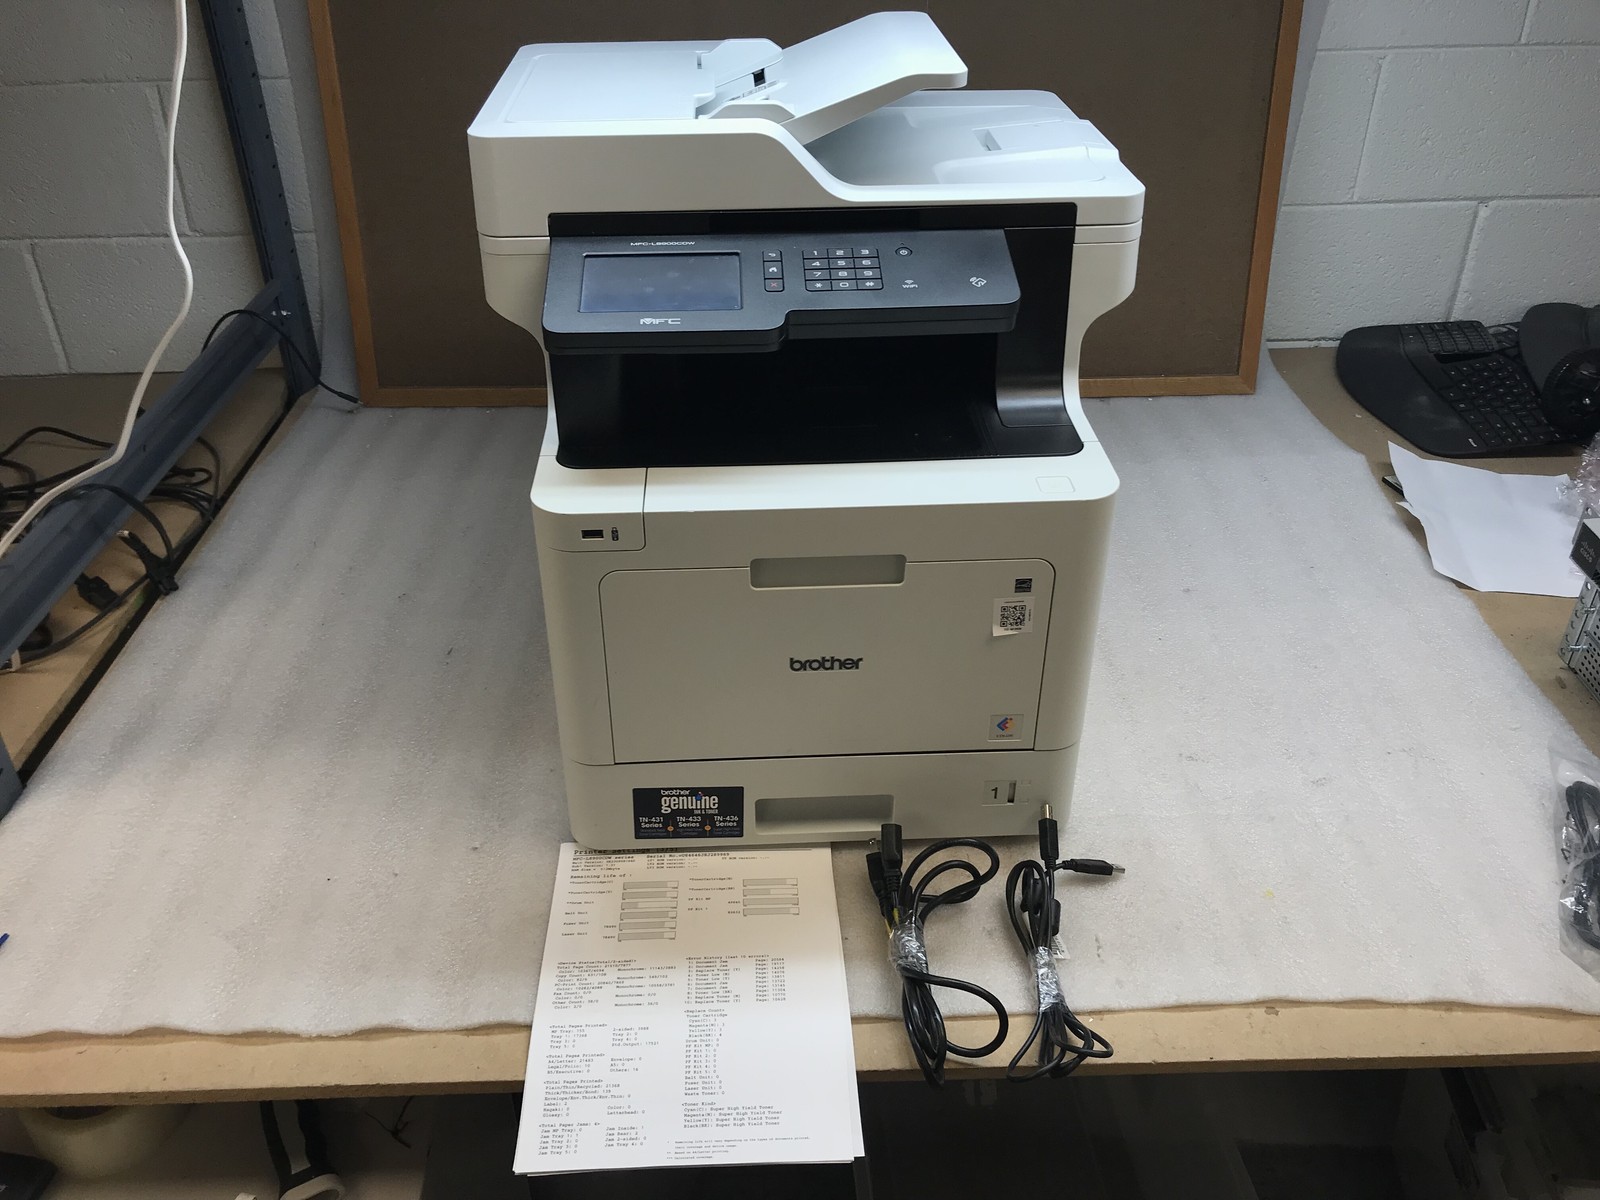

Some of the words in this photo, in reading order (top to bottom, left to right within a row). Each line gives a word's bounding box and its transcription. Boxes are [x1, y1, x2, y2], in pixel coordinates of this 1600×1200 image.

[790, 656, 863, 672] brother
[992, 787, 998, 799] 1
[661, 796, 718, 814] genuine
